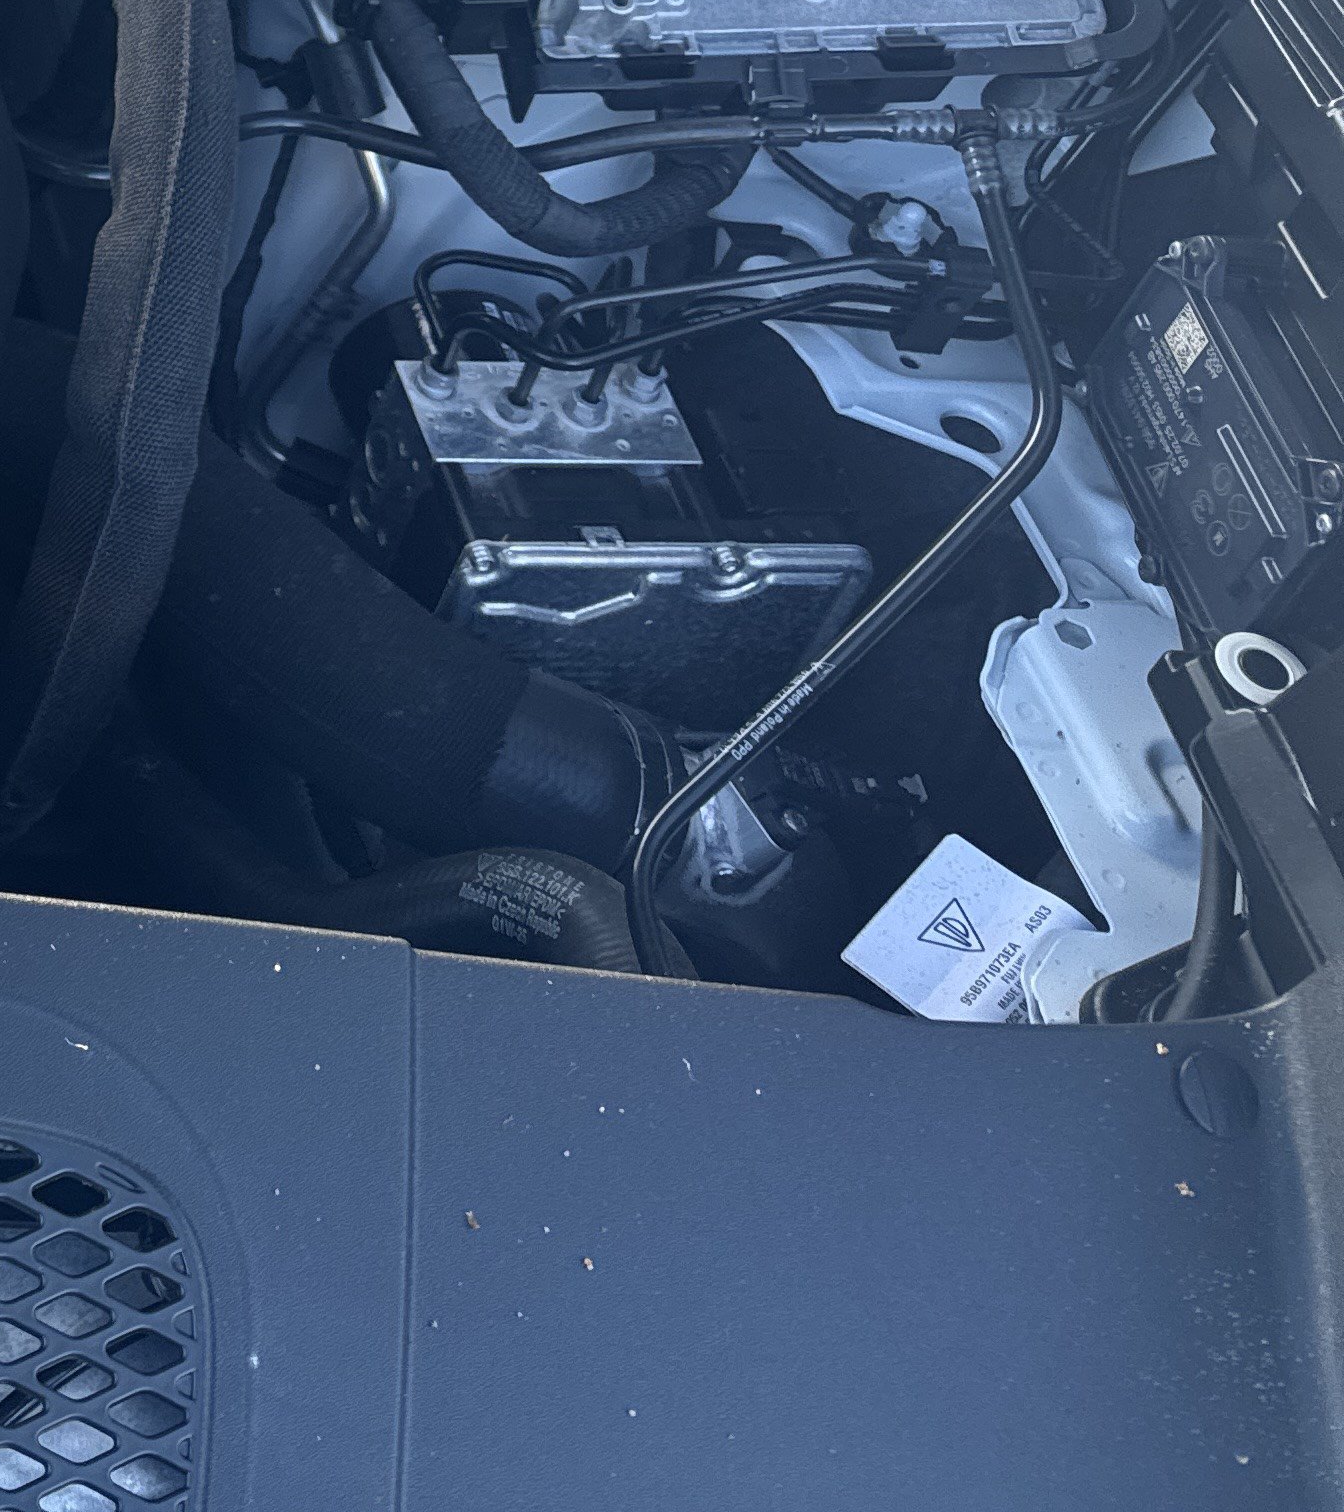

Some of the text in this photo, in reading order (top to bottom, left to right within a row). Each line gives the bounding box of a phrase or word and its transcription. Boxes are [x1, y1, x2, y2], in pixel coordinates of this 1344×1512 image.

[786, 682, 813, 707] Made
[750, 711, 784, 743] Poland
[1024, 905, 1052, 934] AS03
